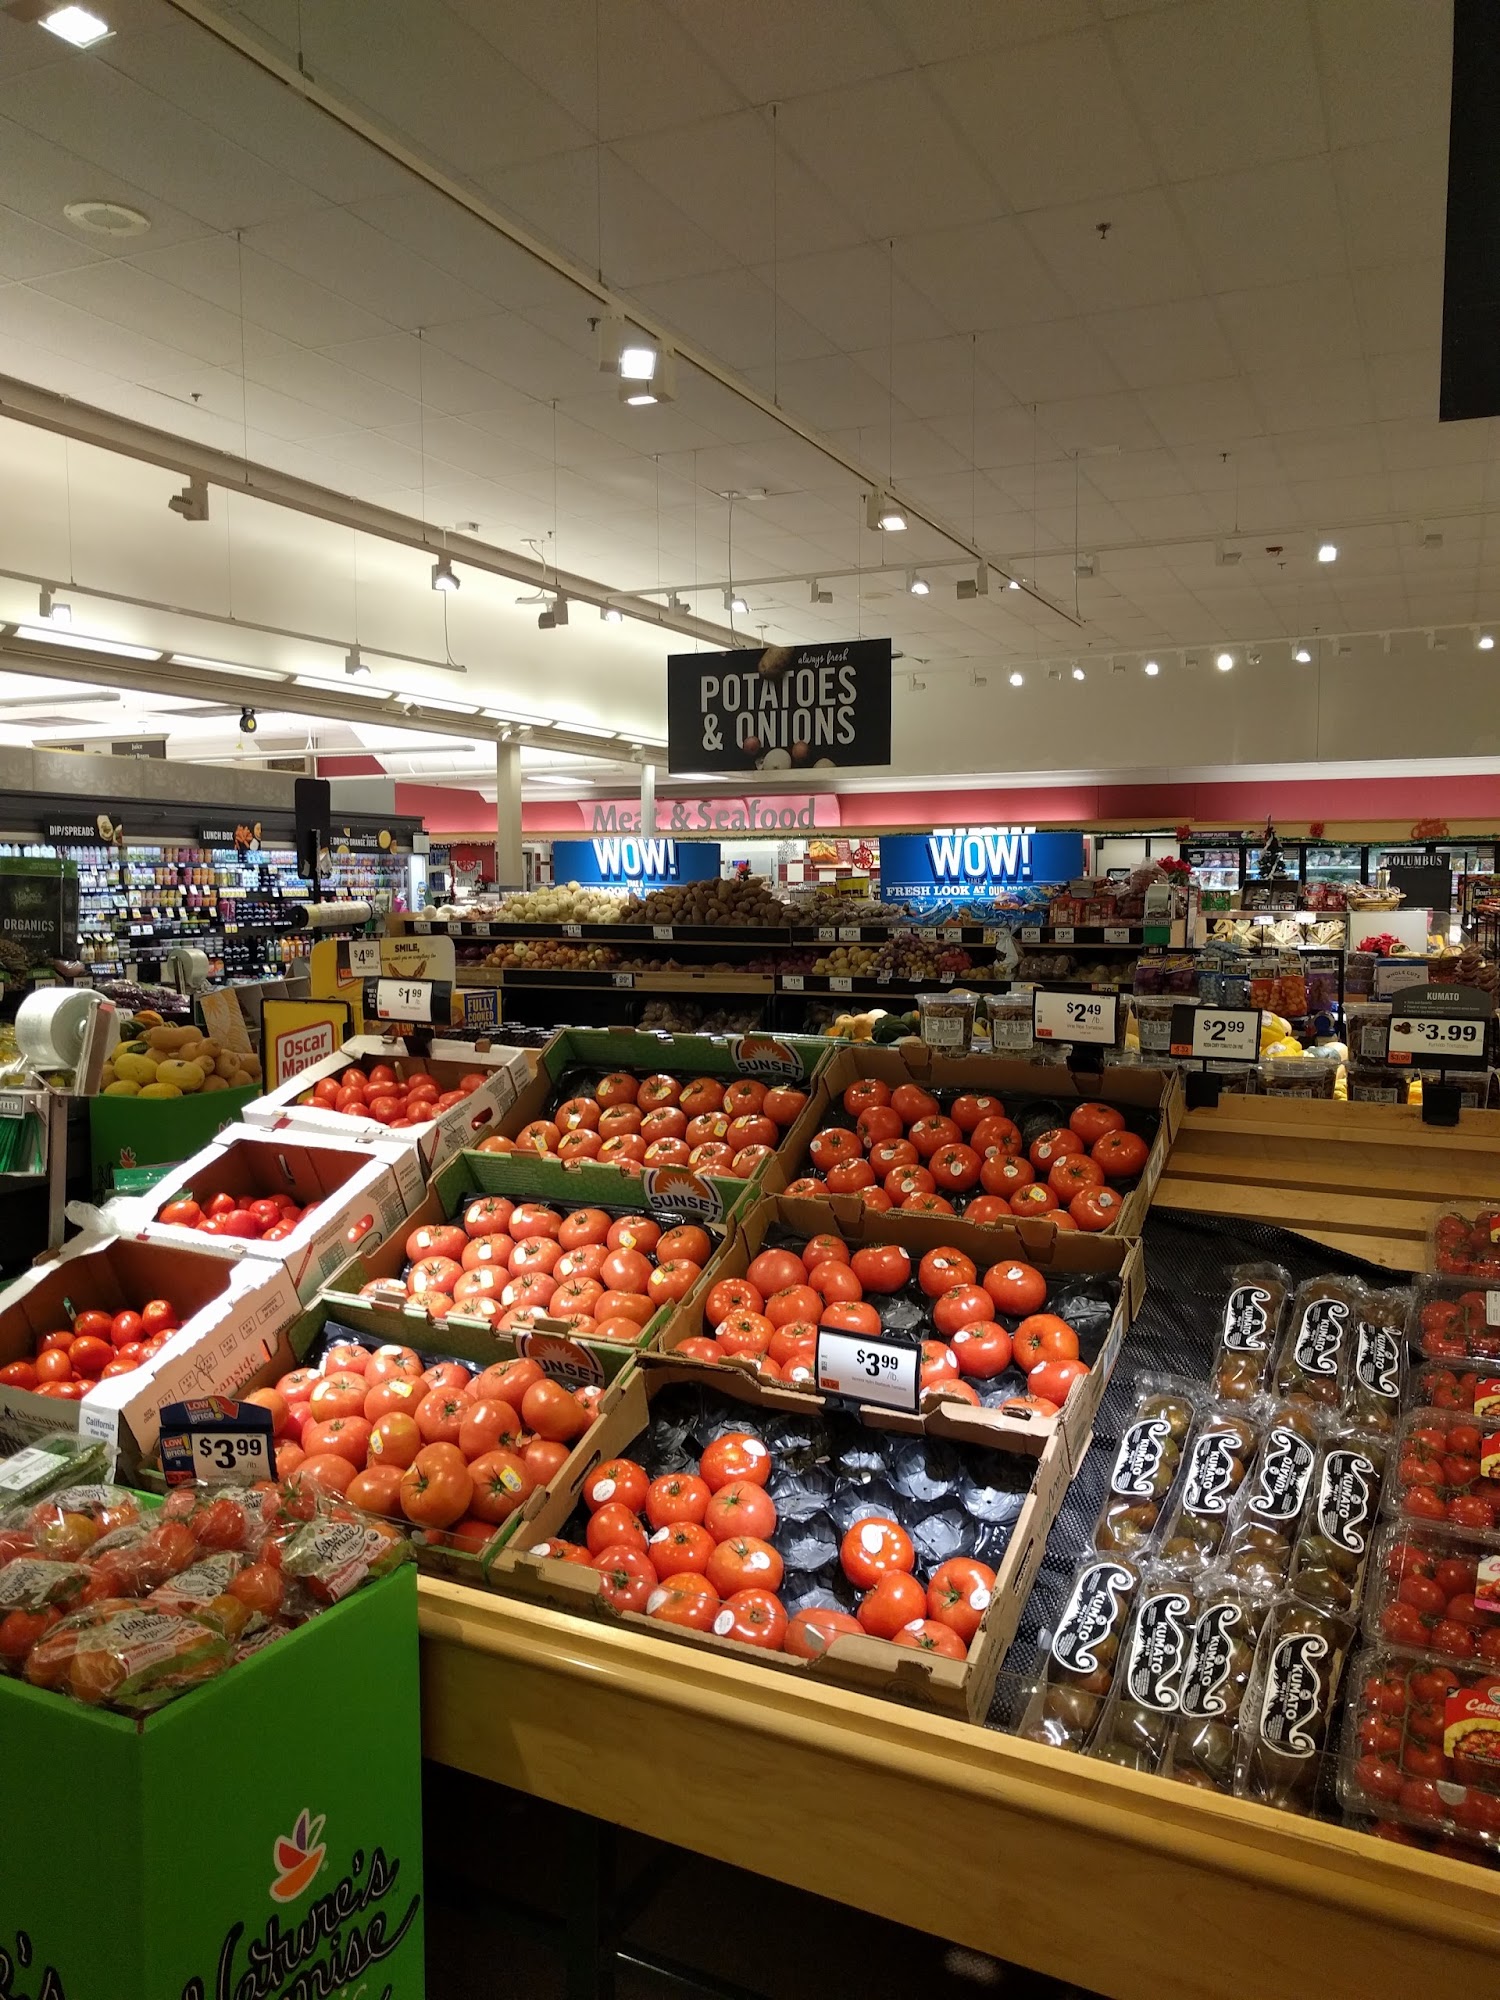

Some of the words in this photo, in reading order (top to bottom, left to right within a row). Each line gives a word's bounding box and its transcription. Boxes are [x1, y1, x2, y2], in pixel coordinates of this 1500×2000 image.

[798, 652, 825, 668] always
[826, 648, 849, 665] fresh
[701, 665, 857, 713] POTATOES
[702, 713, 724, 751] &
[736, 706, 856, 749] ONIONS
[670, 803, 692, 832] &
[697, 797, 816, 833] Seafood
[50, 825, 95, 837] DIP/SPREADS
[203, 830, 221, 840] LUNCH
[222, 831, 233, 841] BOX
[350, 839, 366, 847] ORANGE
[366, 839, 378, 847] JUICE
[592, 838, 677, 876] WOW!
[929, 835, 1031, 877] WOW!
[1386, 855, 1443, 866] COLUMBUS
[886, 886, 931, 897] FRESH
[933, 885, 970, 896] LOOK
[972, 886, 986, 896] AT
[4, 918, 55, 932] ORGANICS
[395, 943, 419, 952] SMILE,
[1386, 971, 1405, 980] WHOLE
[1407, 971, 1421, 979] CUTS
[468, 998, 494, 1012] FULLY
[1427, 992, 1459, 1001] KUMATO
[468, 1011, 494, 1020] COOKED
[1417, 1023, 1476, 1042] $3.99
[284, 1033, 327, 1058] Oscar
[738, 1060, 803, 1077] SUNSET
[651, 1195, 722, 1215] SUNSET
[1243, 1305, 1253, 1335] KUMATO
[1314, 1318, 1330, 1352] KUMATO
[1375, 1333, 1386, 1370] KUMATO
[541, 1360, 603, 1384] UNSET
[187, 1401, 209, 1410] LOW
[86, 1416, 115, 1432] California
[164, 1440, 182, 1448] LOW
[1133, 1439, 1149, 1475] KUMATO
[1203, 1451, 1219, 1489] KUMATO
[1273, 1457, 1293, 1496] KUMATO
[1339, 1472, 1354, 1520] KUMATO
[1078, 1589, 1106, 1642] KUMATO
[1150, 1621, 1167, 1676] KUMATO
[1200, 1634, 1221, 1687] KUMATO
[1287, 1663, 1304, 1721] KUMATO
